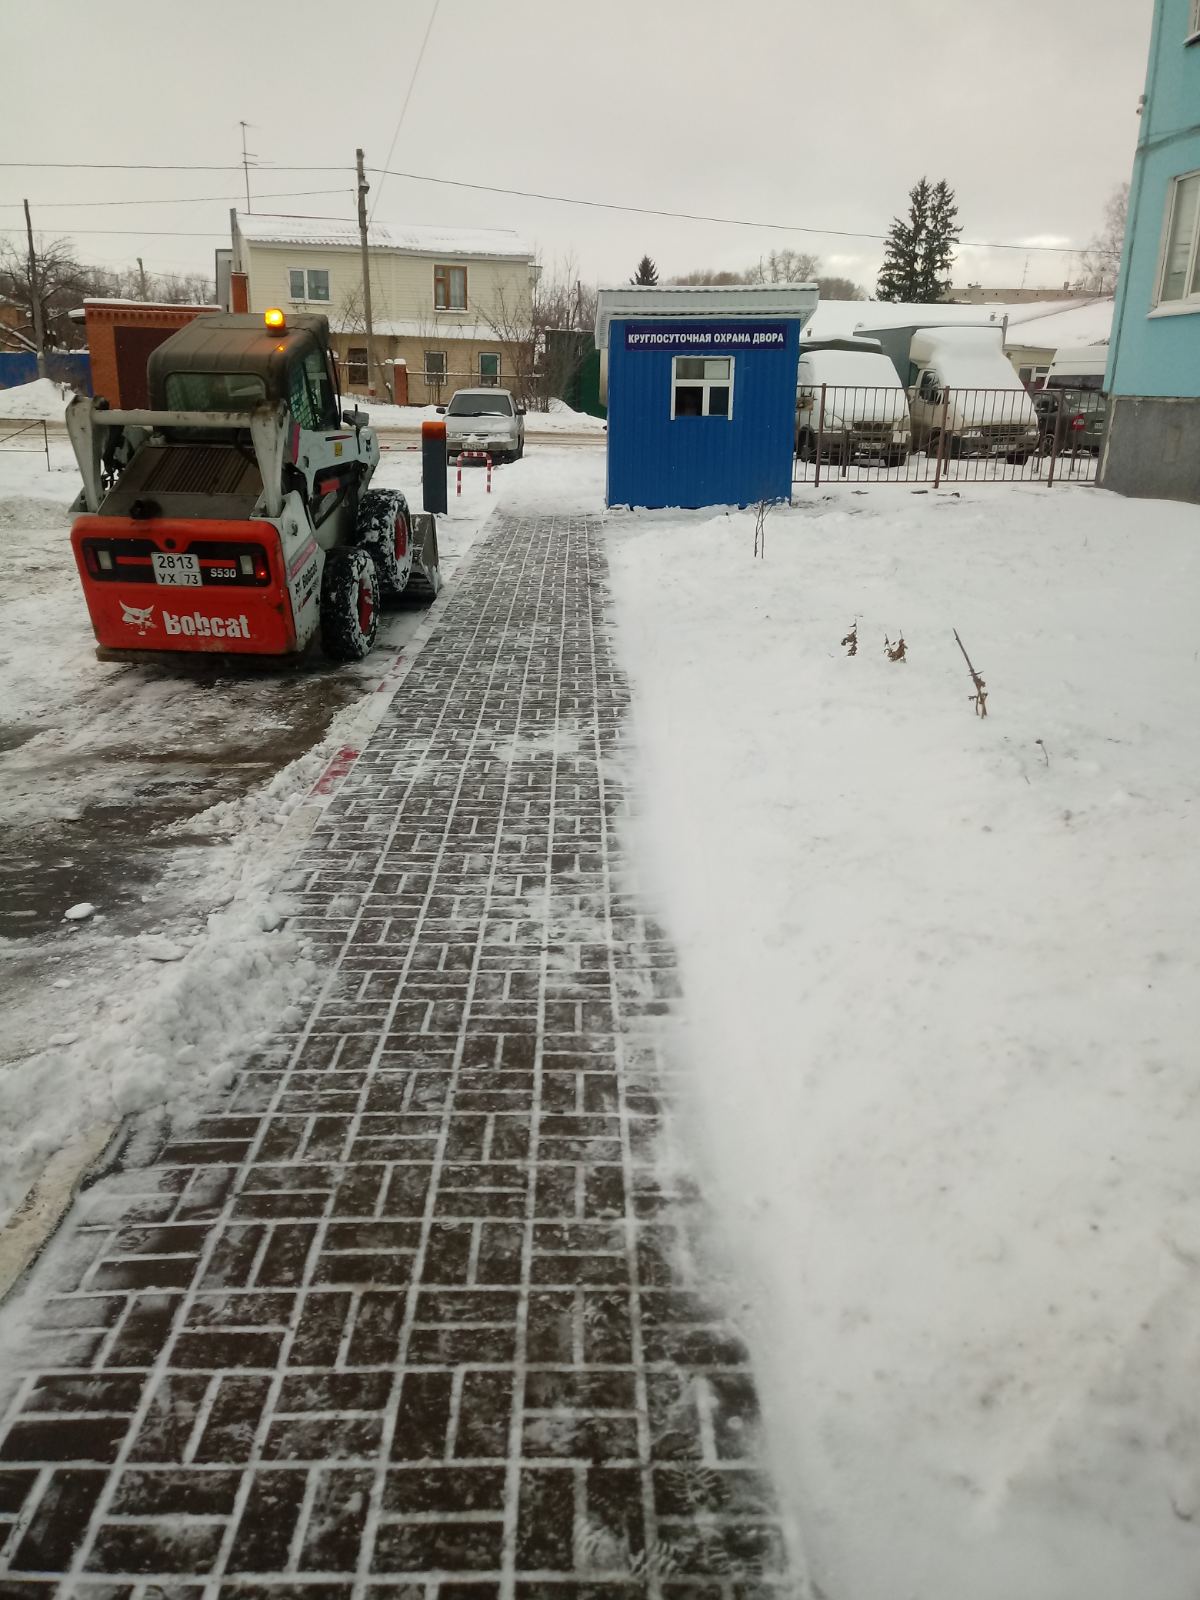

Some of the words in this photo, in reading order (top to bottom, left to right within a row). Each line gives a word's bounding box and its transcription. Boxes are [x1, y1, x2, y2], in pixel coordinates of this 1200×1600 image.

[628, 333, 711, 344] КРУГЛОСУТОЧНАЯ
[714, 333, 750, 343] ОХРАНА
[752, 333, 784, 344] ДВОРА
[157, 555, 194, 569] 2813
[183, 573, 199, 585] 73
[210, 568, 237, 578] S530
[162, 610, 251, 639] Bobcat
